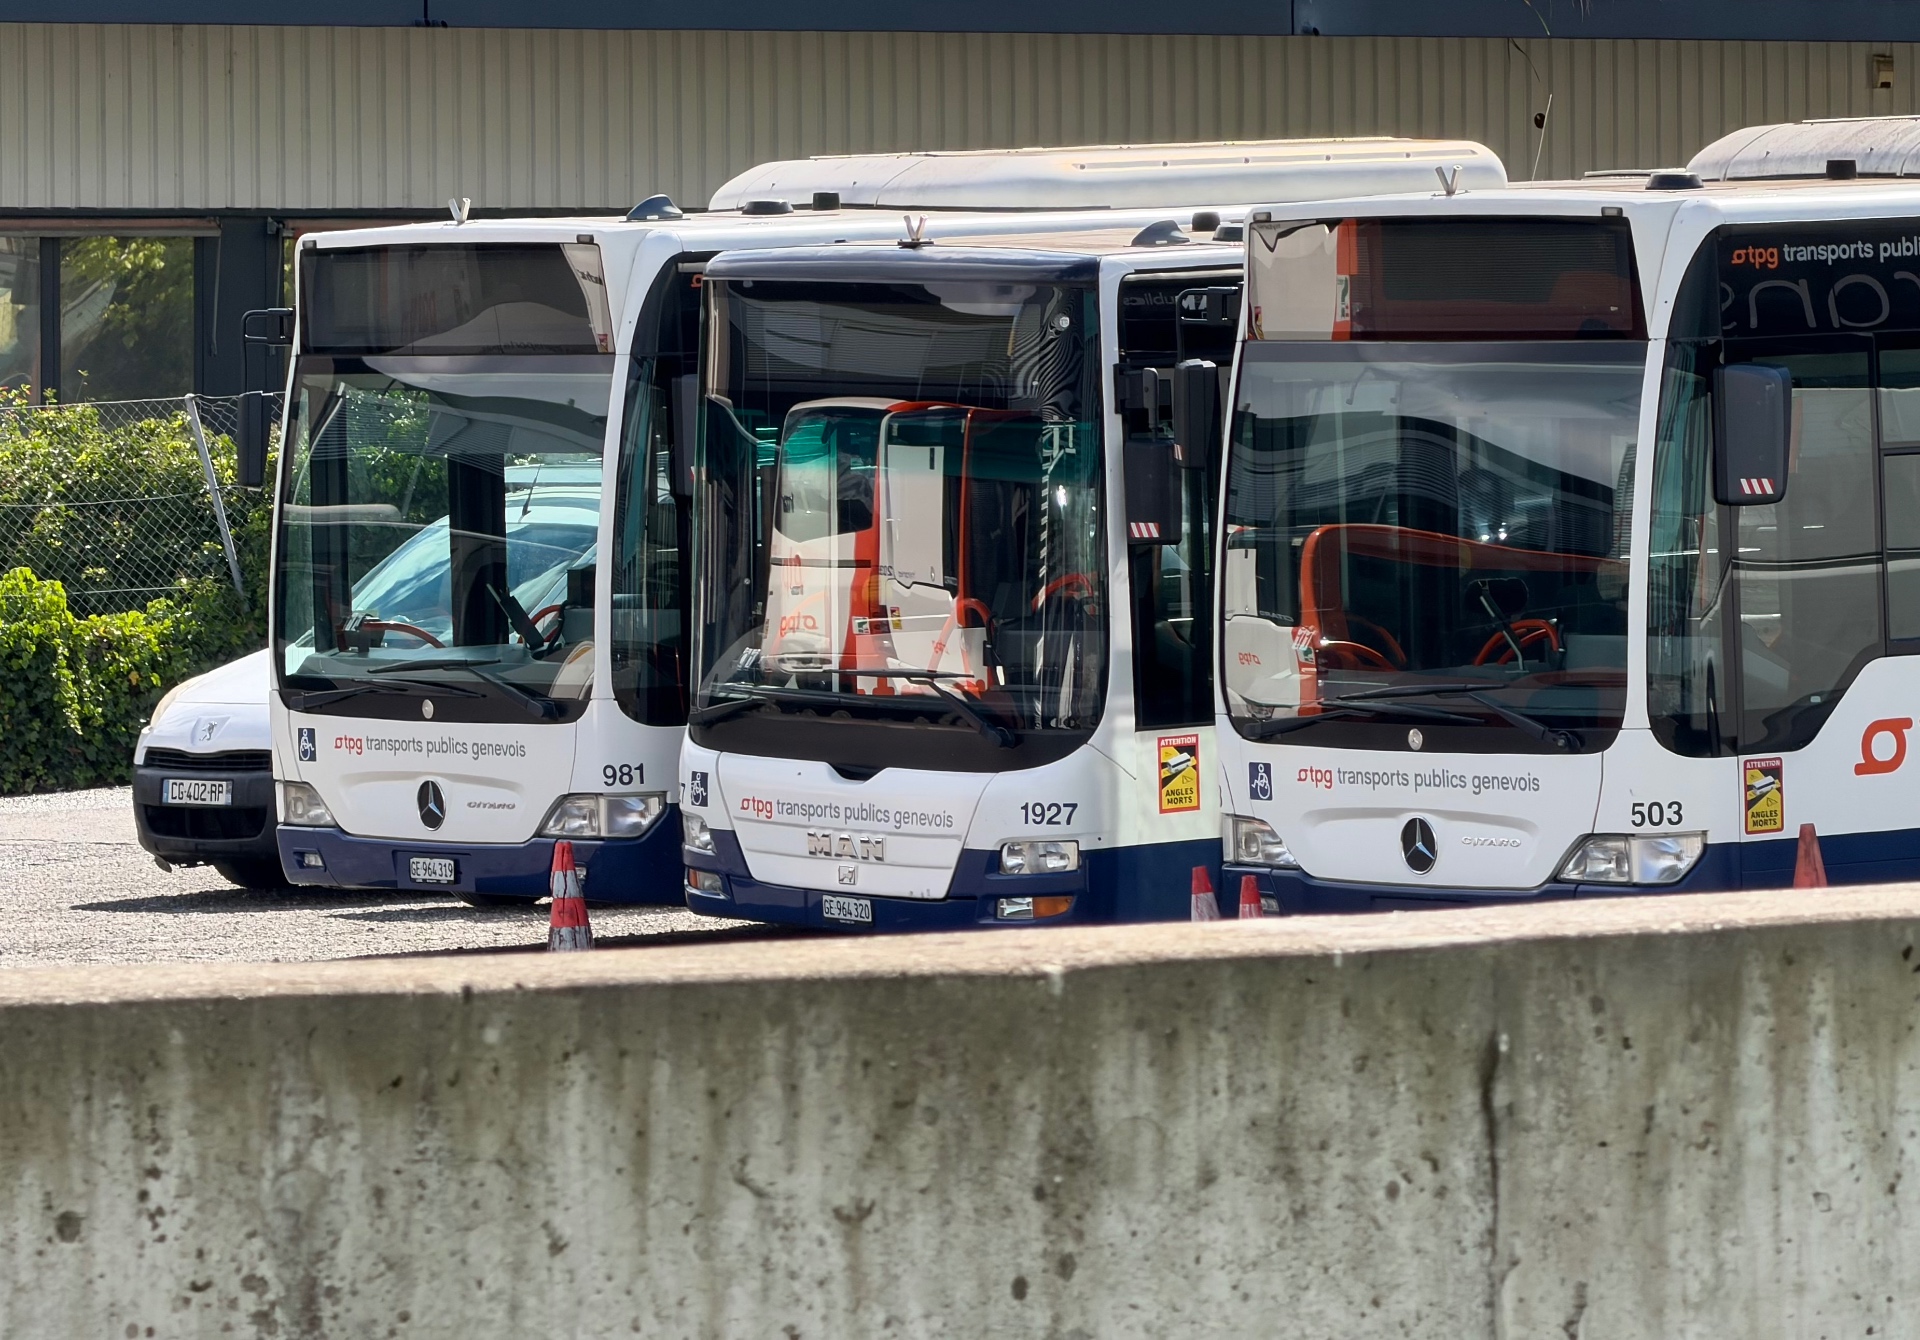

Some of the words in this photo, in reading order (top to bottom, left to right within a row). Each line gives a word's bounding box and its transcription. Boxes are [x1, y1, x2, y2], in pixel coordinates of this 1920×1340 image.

[1782, 240, 1875, 265] transports
[366, 735, 423, 757] transports
[426, 736, 469, 758] publics
[471, 740, 527, 761] genevois
[1159, 736, 1197, 747] ATTENTION
[602, 763, 645, 787] 981
[1746, 759, 1781, 769] ATTENTION
[1165, 787, 1194, 798] ANGLES
[1337, 767, 1410, 791] transports
[1413, 769, 1467, 793] publics
[1471, 772, 1541, 796] genevois
[1166, 796, 1193, 806] MORTS
[776, 799, 841, 822] transports
[844, 802, 891, 825] publics
[893, 810, 954, 830] genevois
[1020, 802, 1079, 826] 1927
[1630, 801, 1684, 827] 503
[1750, 809, 1779, 819] ANGLES
[1752, 818, 1778, 828] MORTS
[807, 831, 885, 862] MAN
[1461, 836, 1522, 848] CITARO
